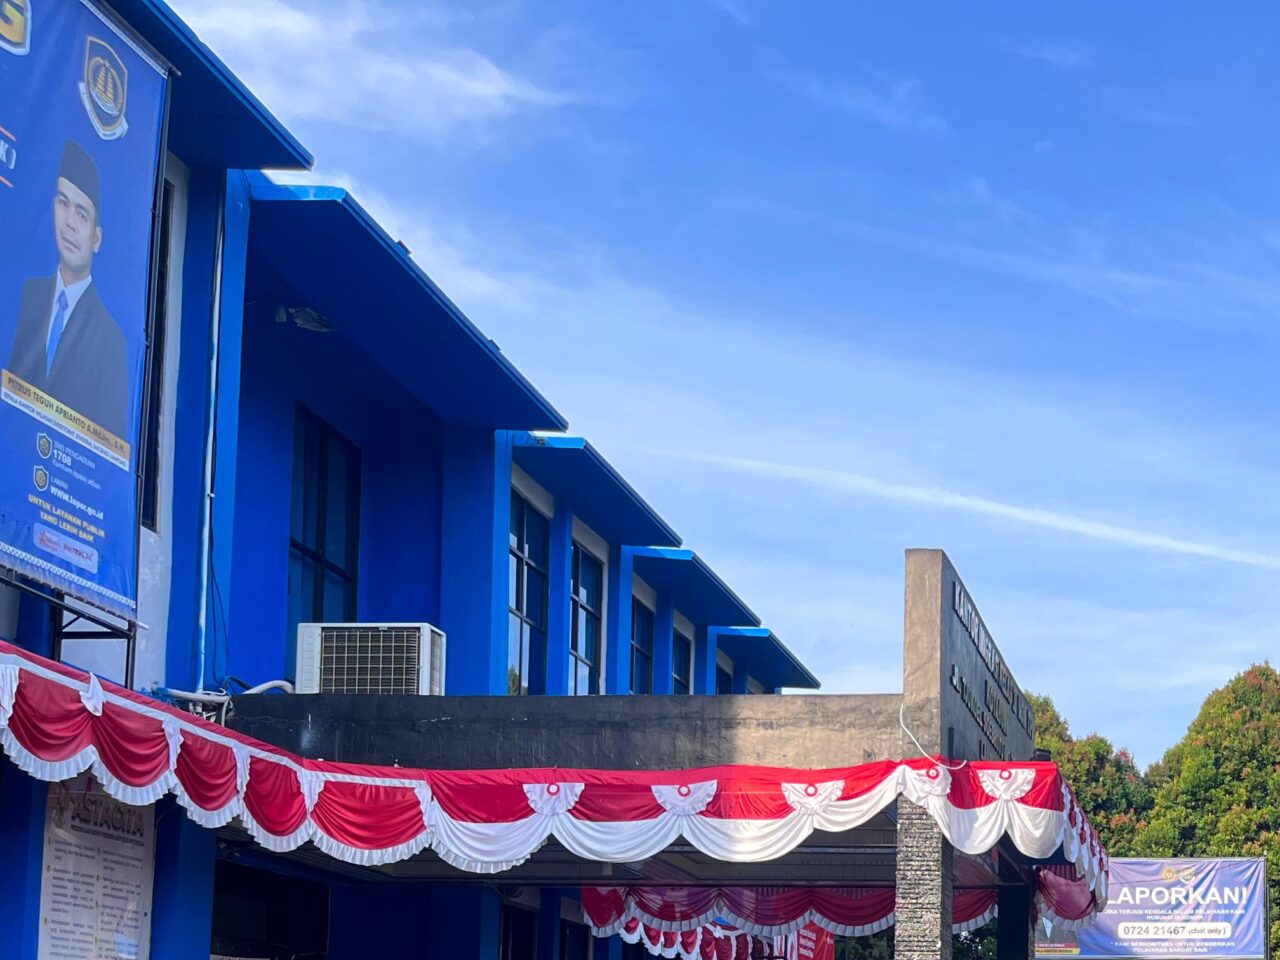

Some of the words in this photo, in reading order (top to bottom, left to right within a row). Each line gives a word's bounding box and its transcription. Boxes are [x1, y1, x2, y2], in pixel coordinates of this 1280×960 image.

[32, 390, 54, 411] TEGUH
[54, 405, 86, 429] APRIANTO
[53, 449, 71, 466] 1708
[1123, 926, 1150, 935] 0724
[1153, 926, 1186, 935] 21467
